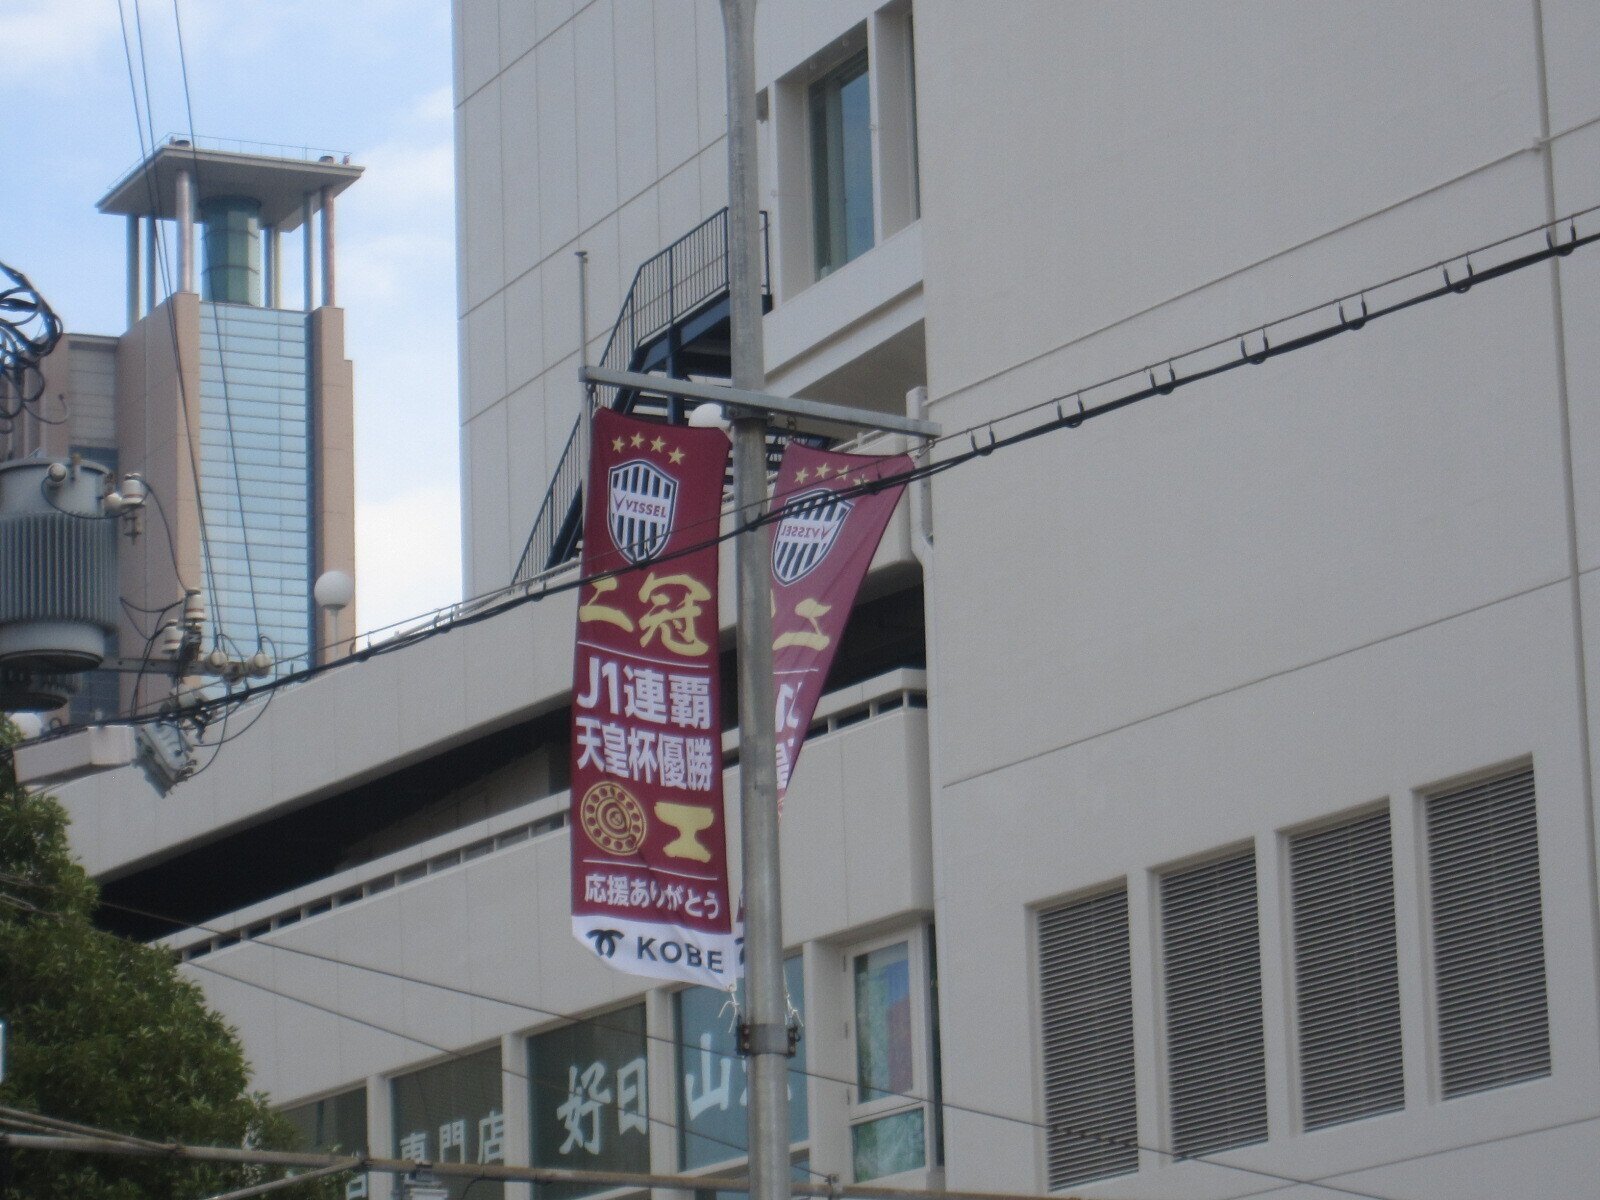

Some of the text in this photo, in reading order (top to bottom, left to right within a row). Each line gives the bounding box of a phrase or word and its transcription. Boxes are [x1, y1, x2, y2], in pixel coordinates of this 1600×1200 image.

[625, 499, 667, 518] VISSEL
[577, 570, 712, 657] 二冠
[576, 656, 712, 730] J1連覇
[576, 716, 713, 791] 天皇杯優勝
[584, 873, 720, 920] 応援ありがとう
[637, 936, 724, 974] KOBE
[556, 1032, 792, 1155] 好日山
